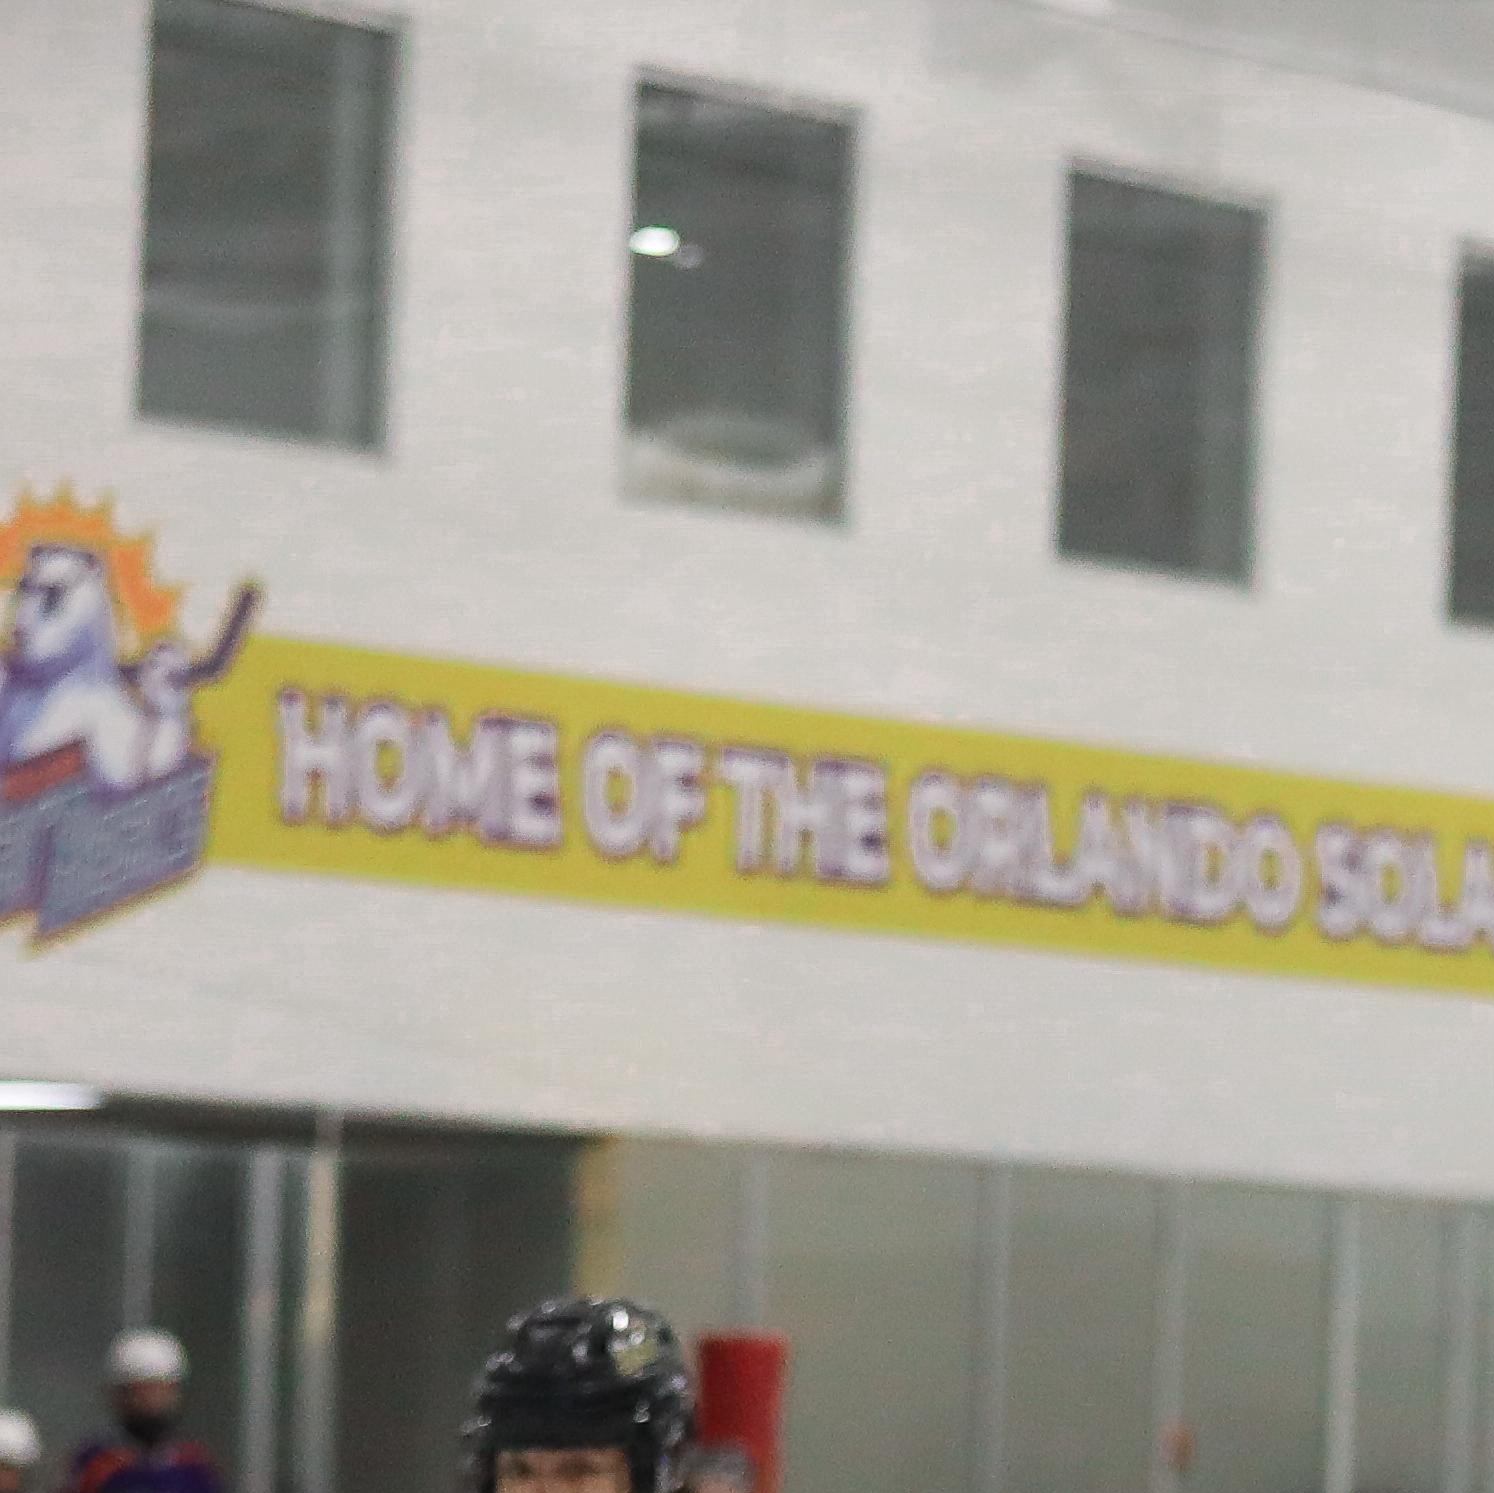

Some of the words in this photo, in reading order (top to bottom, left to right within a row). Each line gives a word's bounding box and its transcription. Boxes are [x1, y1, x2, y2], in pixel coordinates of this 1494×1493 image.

[279, 684, 563, 850] HOME
[583, 724, 711, 864] OF
[718, 744, 890, 887] THE
[907, 768, 1302, 932] ORLANDO
